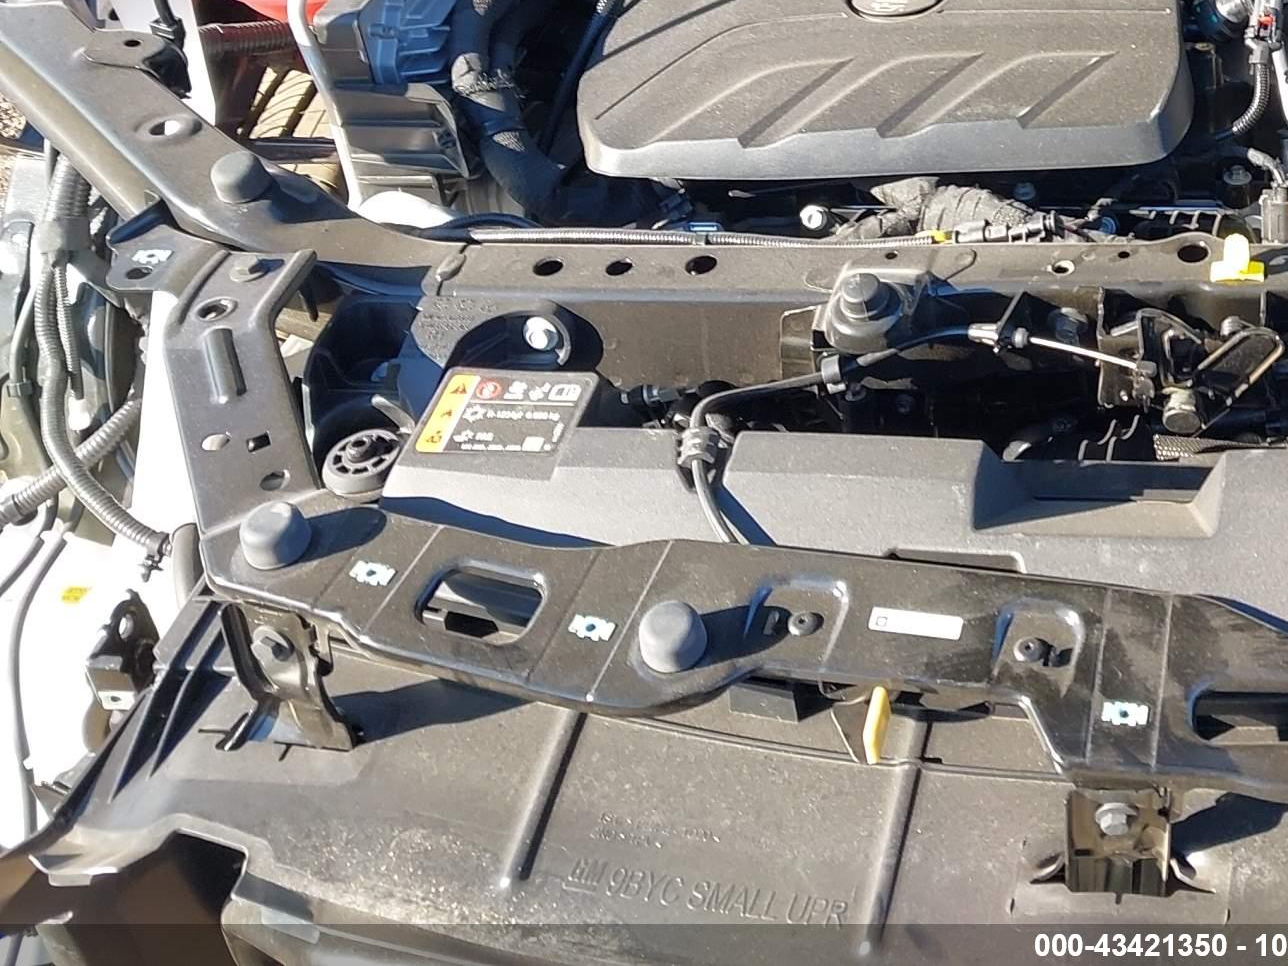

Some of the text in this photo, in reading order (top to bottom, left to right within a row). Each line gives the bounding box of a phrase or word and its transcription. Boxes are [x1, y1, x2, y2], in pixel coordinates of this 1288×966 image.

[605, 866, 684, 906] 9BYC
[686, 880, 777, 921] SMALL
[785, 892, 849, 930] UPR
